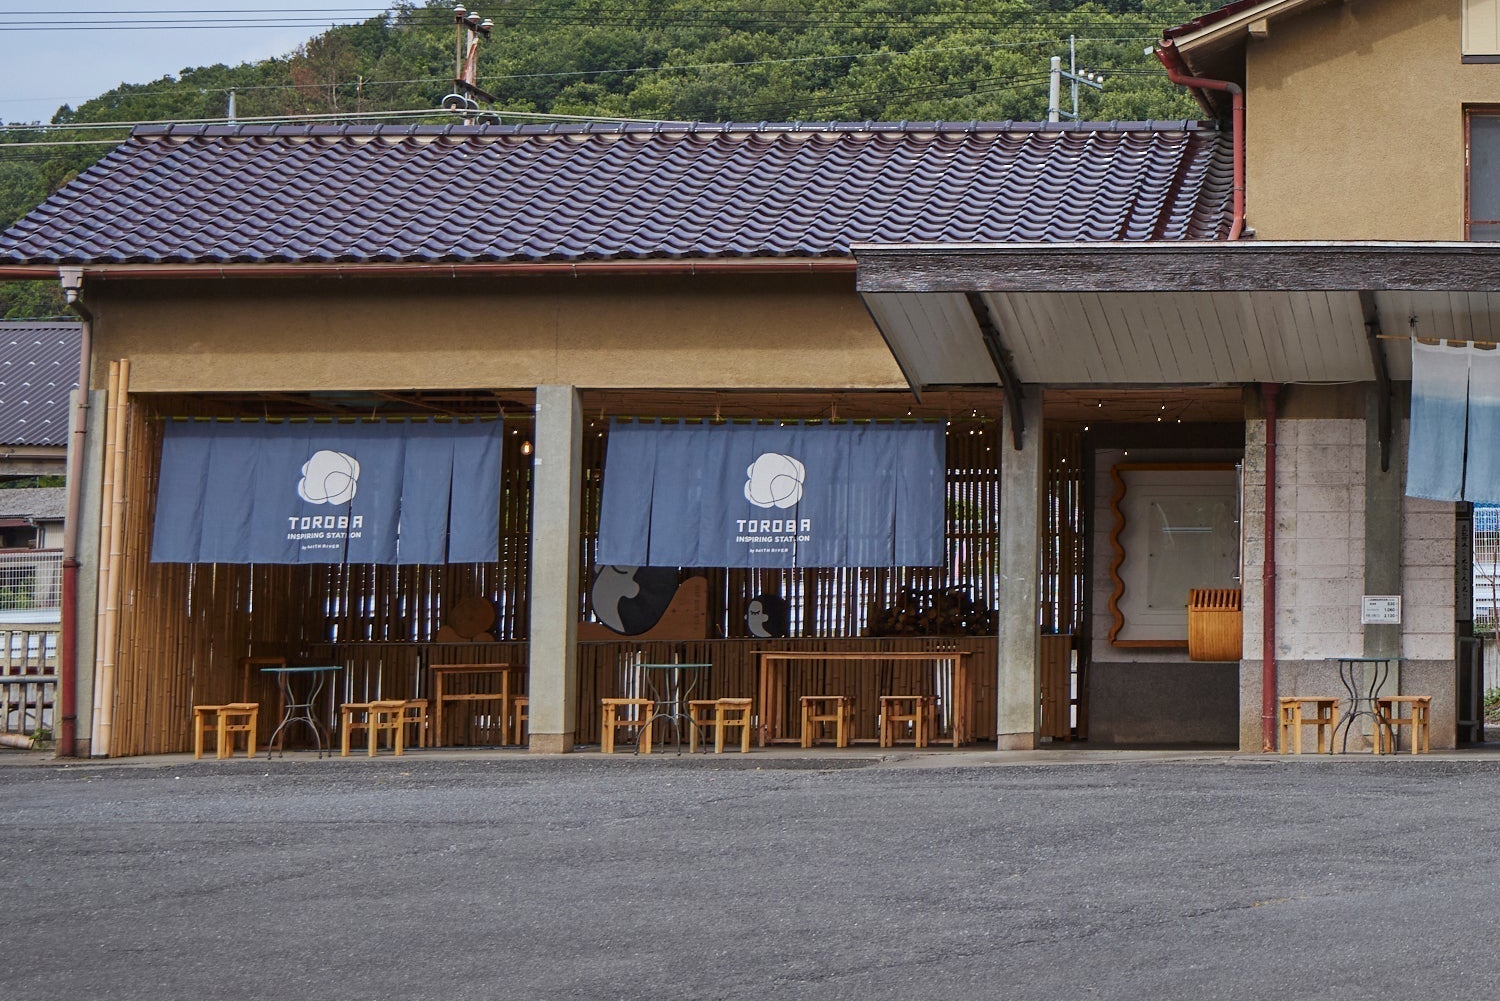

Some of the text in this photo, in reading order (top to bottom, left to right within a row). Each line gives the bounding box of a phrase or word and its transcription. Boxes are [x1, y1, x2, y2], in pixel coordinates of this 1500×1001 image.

[288, 515, 363, 530] TOROBA
[736, 518, 811, 533] TOROBA
[287, 531, 325, 540] INSPIRING
[735, 535, 773, 543] INSPIRING
